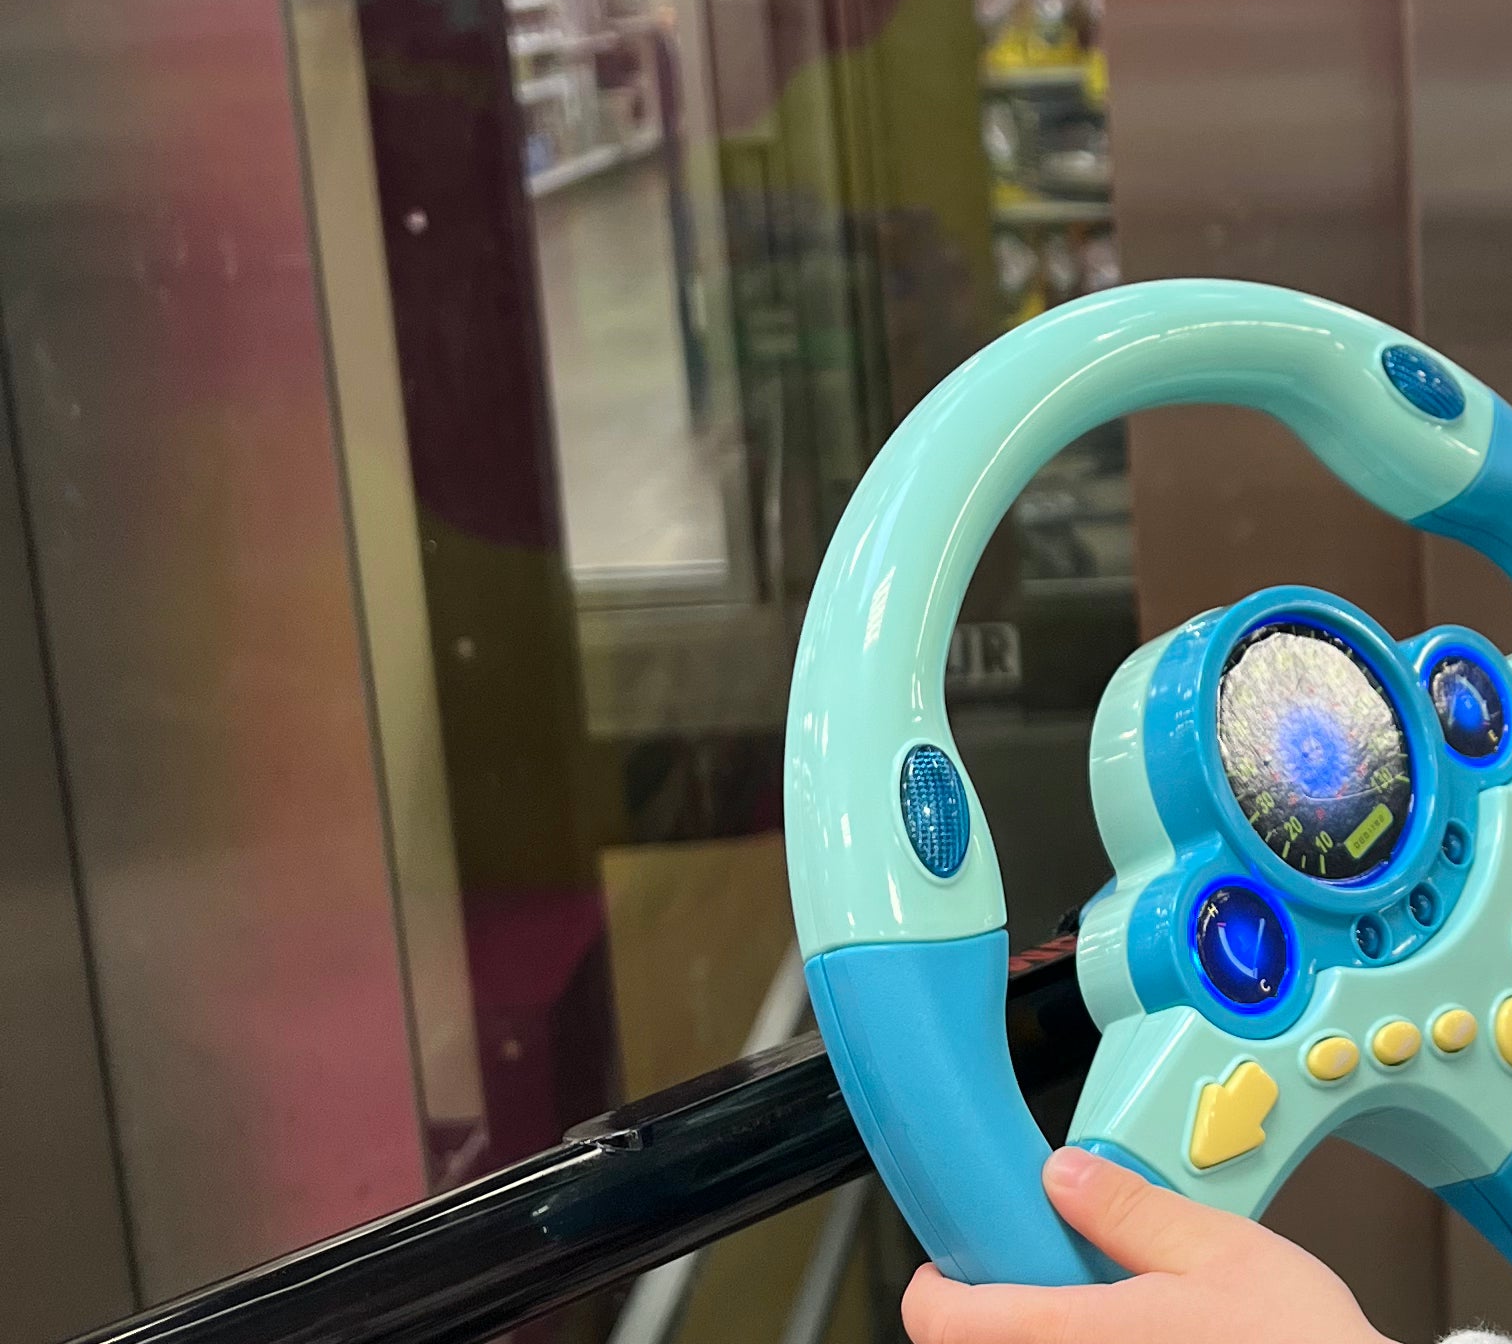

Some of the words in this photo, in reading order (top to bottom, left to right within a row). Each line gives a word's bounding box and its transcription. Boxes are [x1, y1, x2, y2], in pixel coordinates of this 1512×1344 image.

[1256, 791, 1275, 814] 30
[1284, 816, 1303, 841] 20
[1315, 831, 1333, 853] 10
[1260, 978, 1271, 992] C
